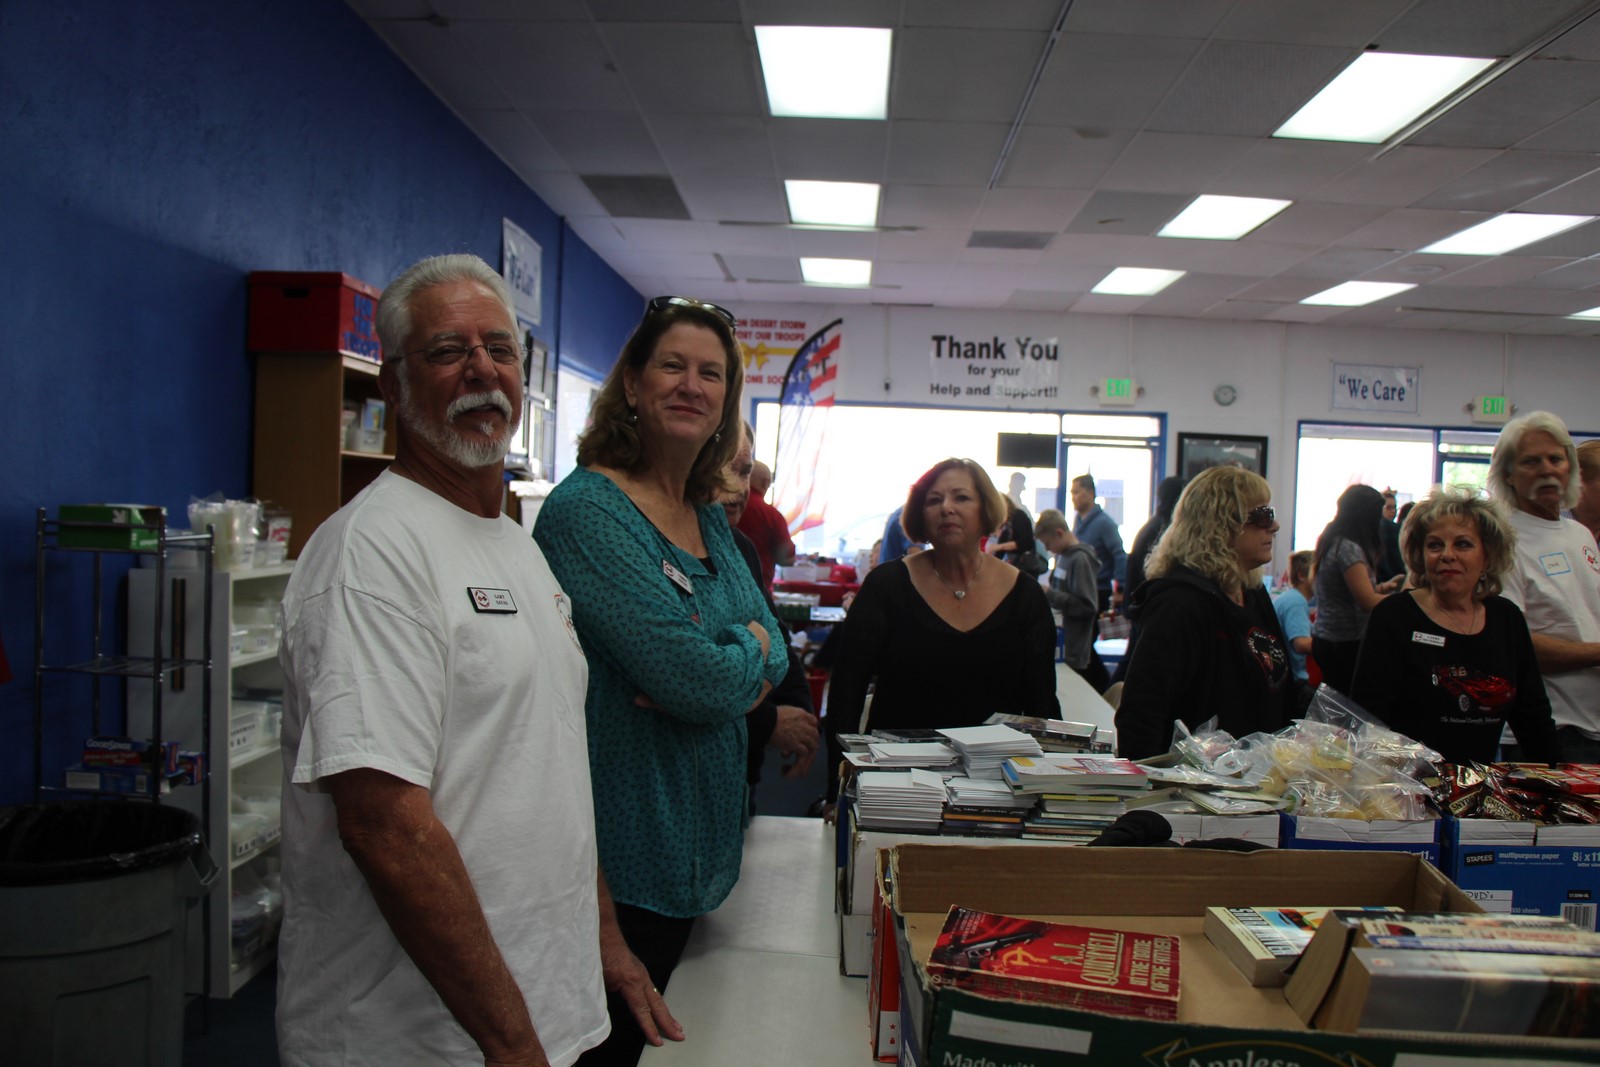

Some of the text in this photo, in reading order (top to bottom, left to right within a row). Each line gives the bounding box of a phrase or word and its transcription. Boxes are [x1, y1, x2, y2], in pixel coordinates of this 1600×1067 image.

[750, 319, 778, 329] DESERT
[780, 320, 806, 330] STORM
[755, 332, 771, 341] OUR
[775, 332, 806, 342] TROOPS
[931, 335, 1058, 361] Thank You
[967, 364, 1020, 378] for your
[930, 384, 1058, 399] Help and Support!!
[1107, 379, 1132, 397] EXIT
[1483, 396, 1505, 415] EXIT
[1466, 854, 1493, 863] STAPLES
[1498, 852, 1560, 861] multipurpose paper
[1079, 932, 1124, 986] QUINNELL
[1153, 937, 1173, 966] FATHER
[1129, 938, 1152, 987] IN THE NAME
[1151, 965, 1171, 981] THE
[1150, 980, 1170, 993] OF
